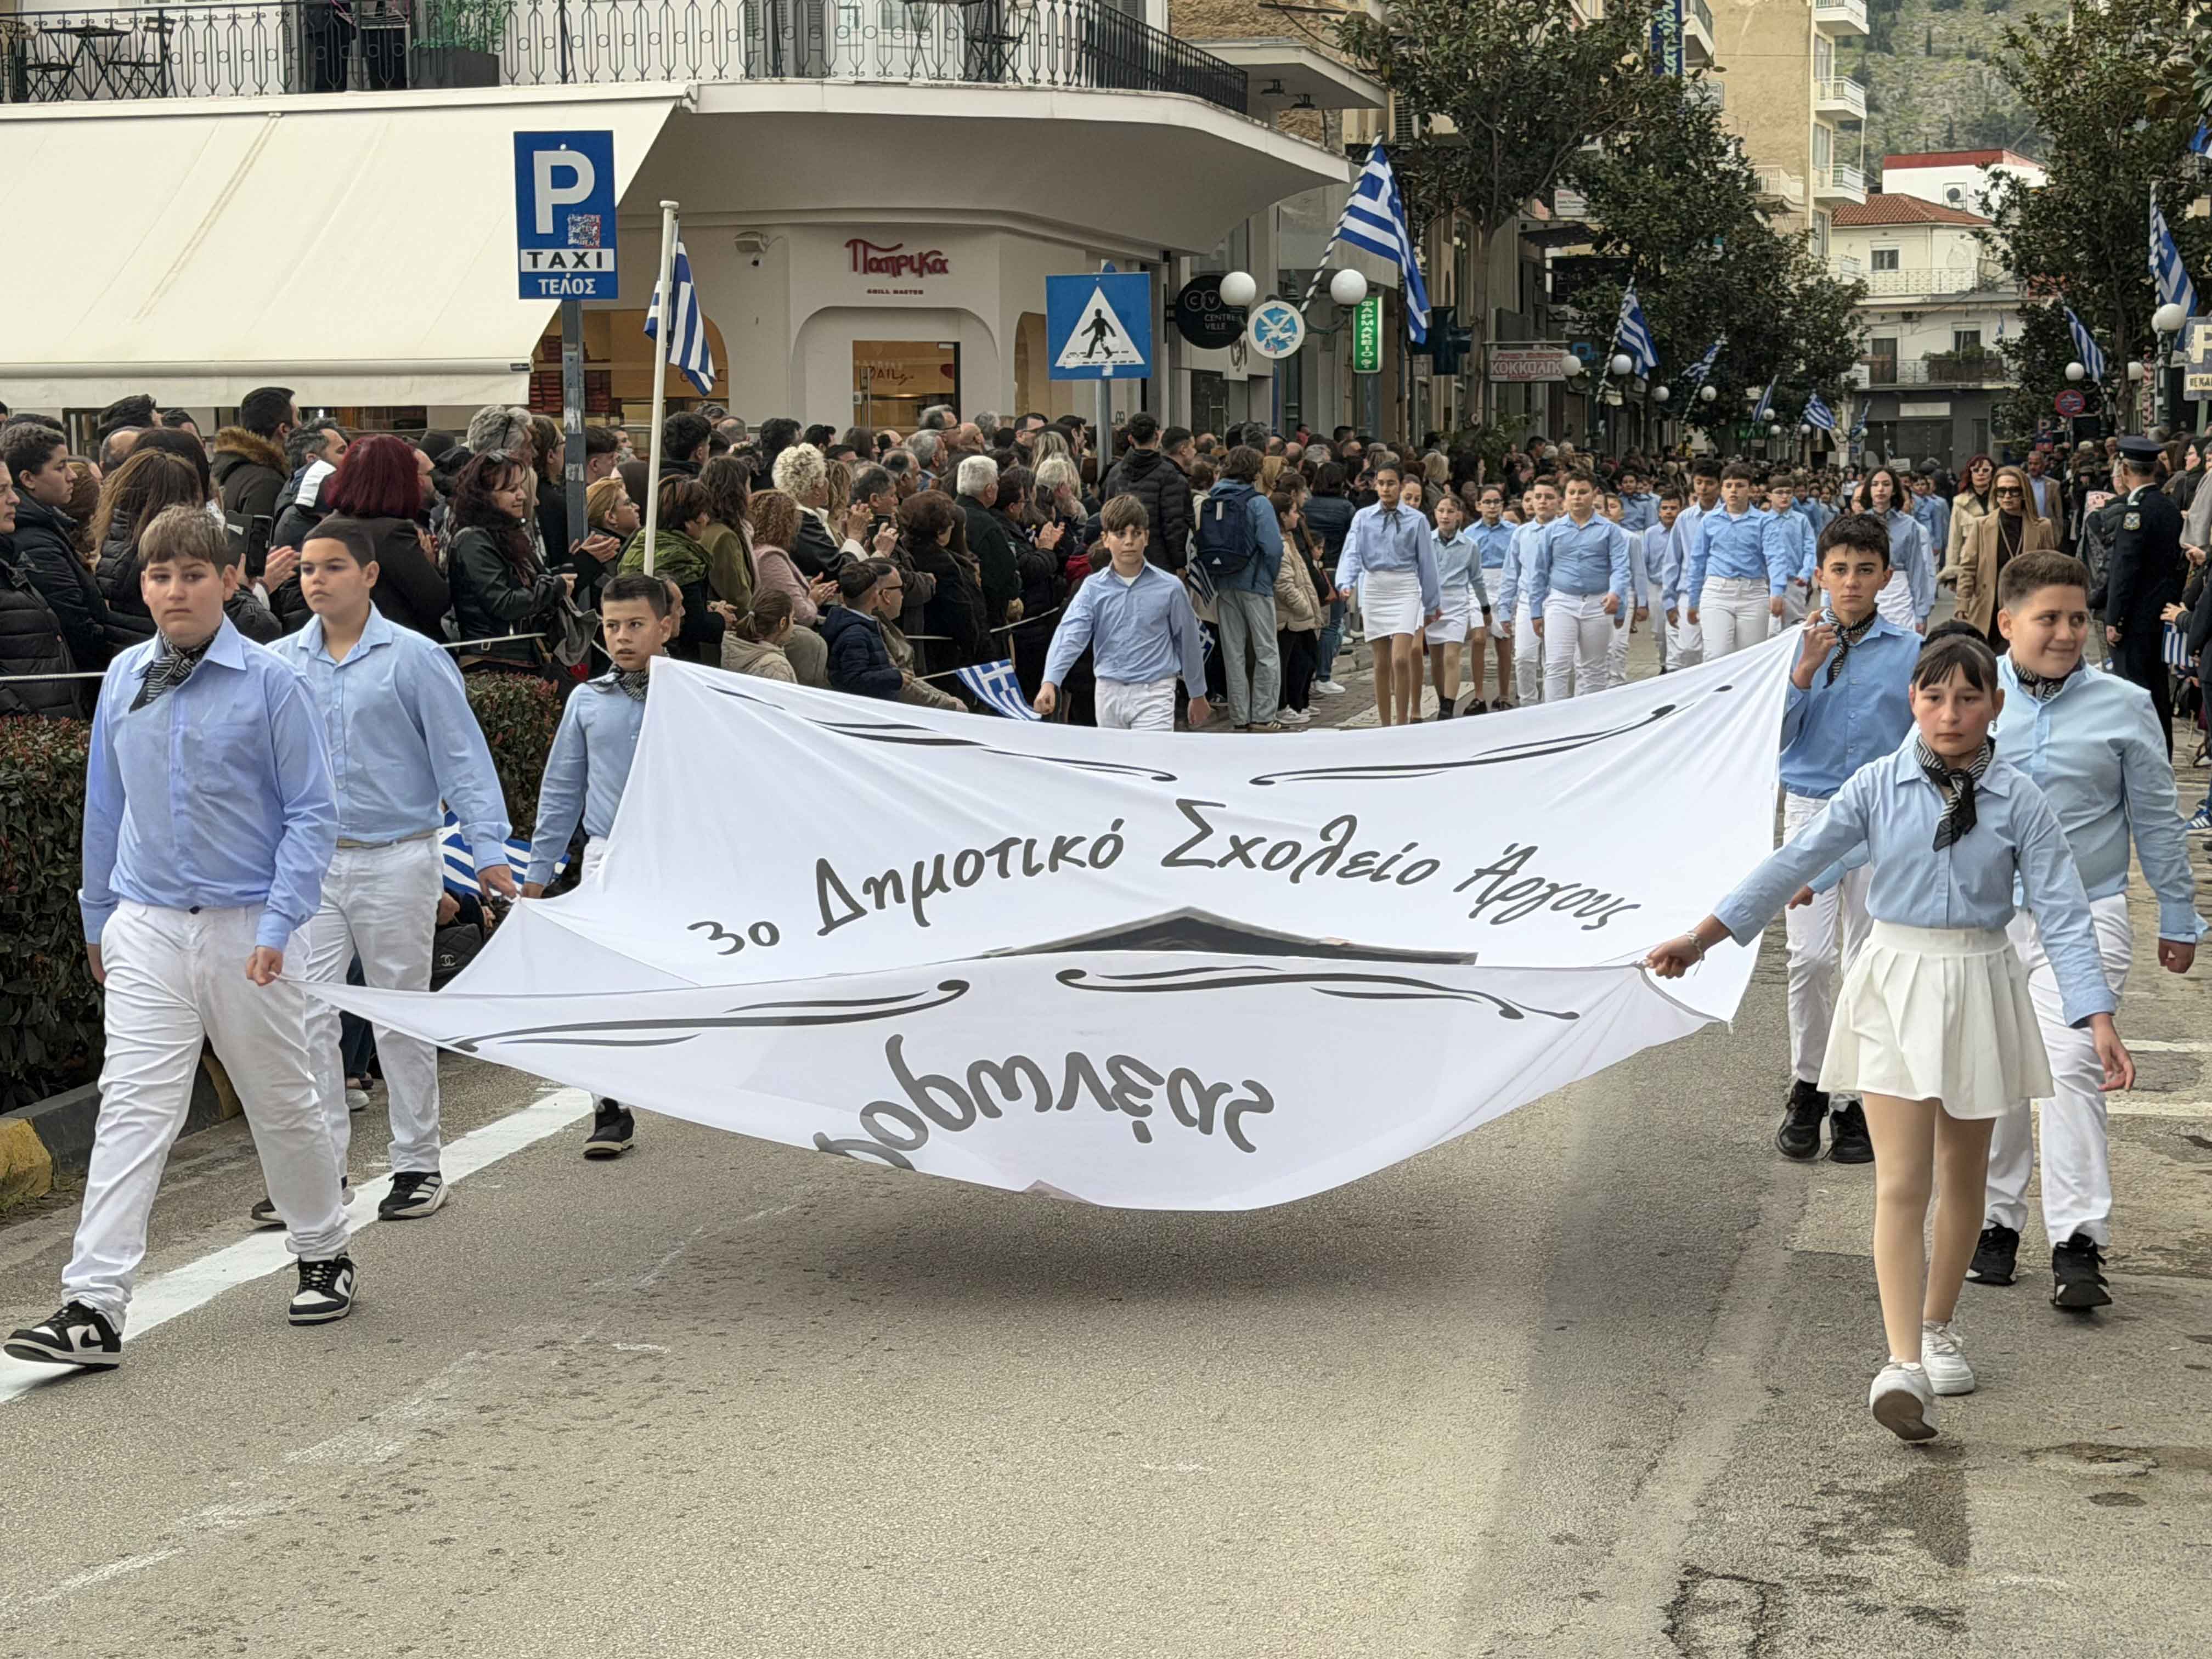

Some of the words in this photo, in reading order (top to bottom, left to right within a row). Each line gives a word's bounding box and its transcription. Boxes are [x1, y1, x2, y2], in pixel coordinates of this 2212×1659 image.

[533, 150, 595, 234] P
[527, 251, 603, 268] TAXI
[687, 921, 780, 955] 3ο
[816, 818, 1125, 936] Δημοτικό
[1161, 798, 1440, 885] Σχολείο
[1453, 843, 1640, 930] Άργους
